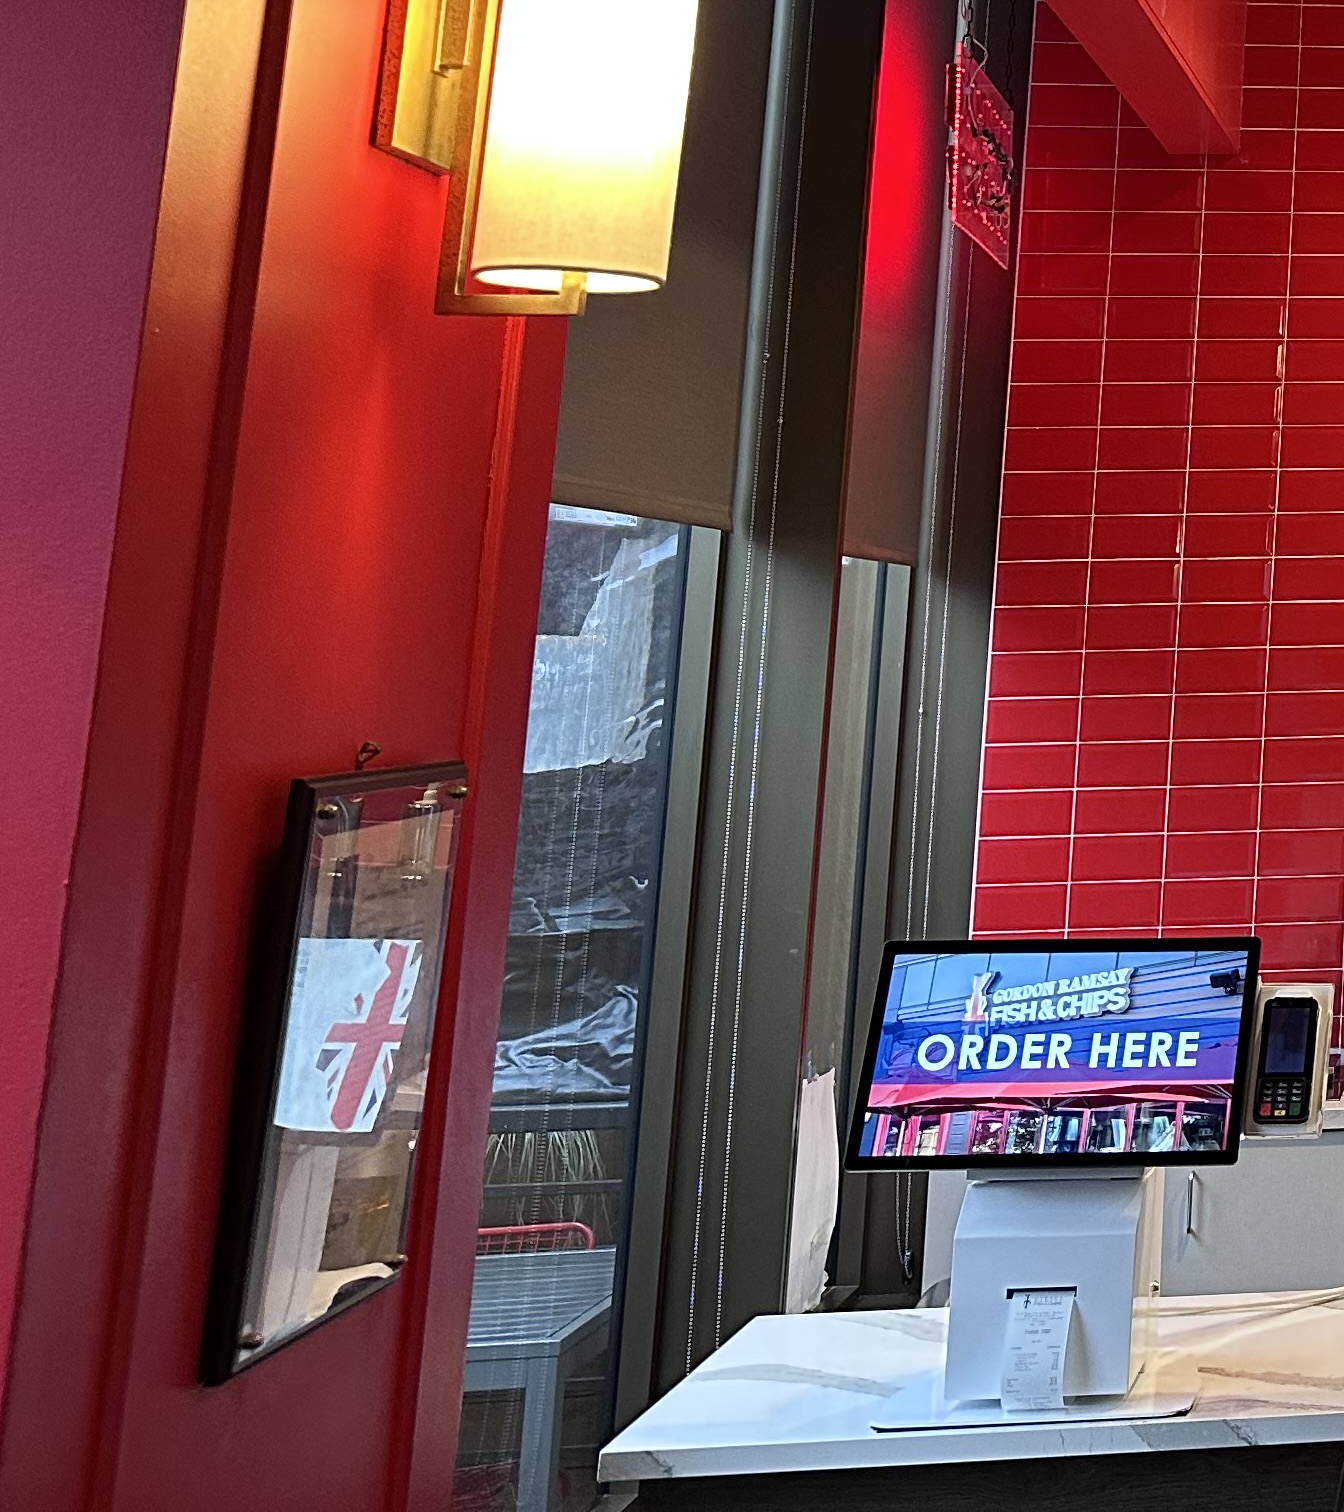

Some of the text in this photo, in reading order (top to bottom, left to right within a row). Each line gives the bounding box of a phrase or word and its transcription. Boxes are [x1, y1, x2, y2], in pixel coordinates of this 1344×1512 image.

[989, 985, 1131, 1028] FISH & CHIPS
[992, 966, 1133, 1006] GORDON RAMSAY
[917, 1030, 1201, 1073] ORDER HERE
